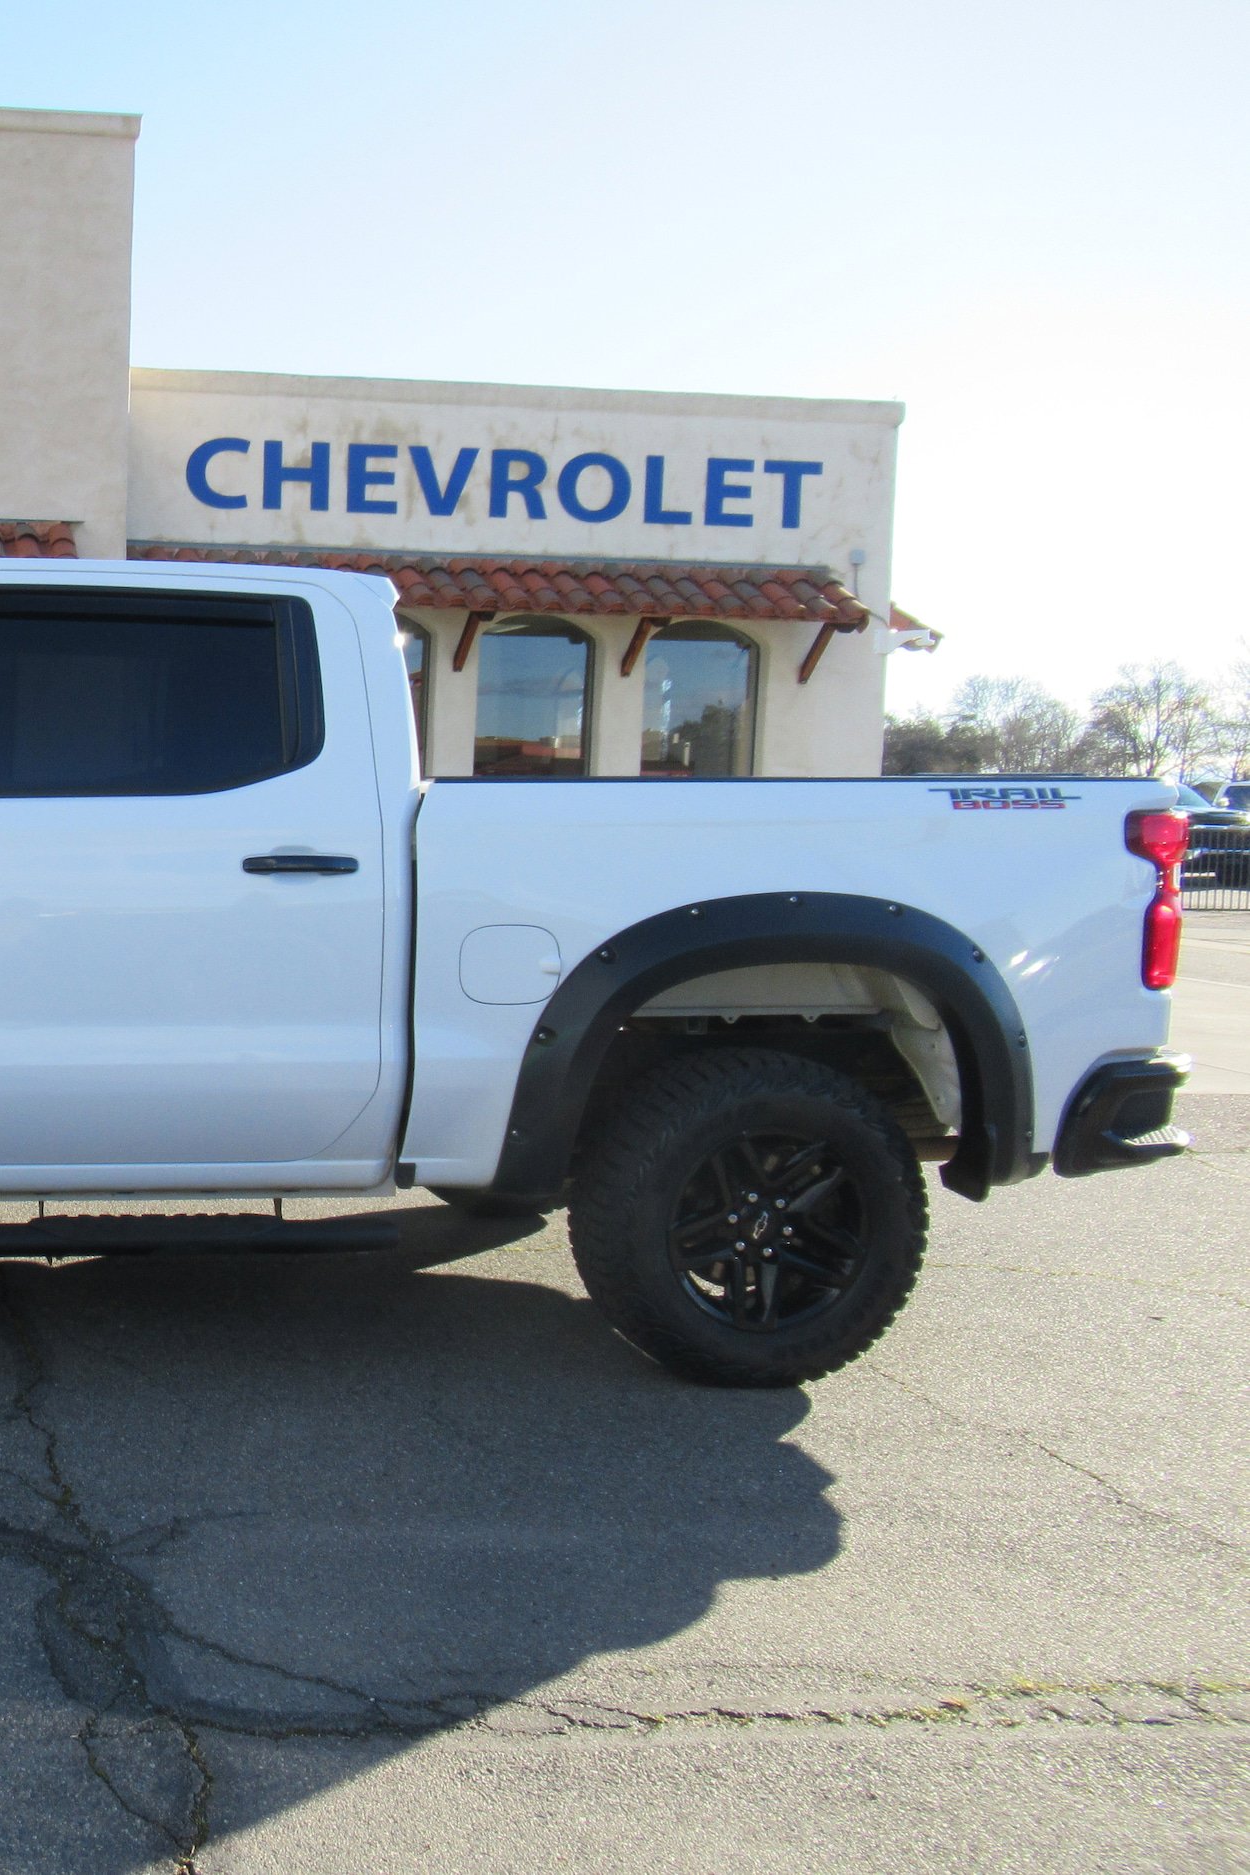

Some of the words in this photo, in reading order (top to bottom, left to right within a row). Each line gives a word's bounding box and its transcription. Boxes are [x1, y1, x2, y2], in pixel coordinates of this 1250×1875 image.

[185, 437, 824, 529] CHEVROLET
[928, 787, 1082, 800] TRAIL
[952, 800, 1067, 810] BOSS
